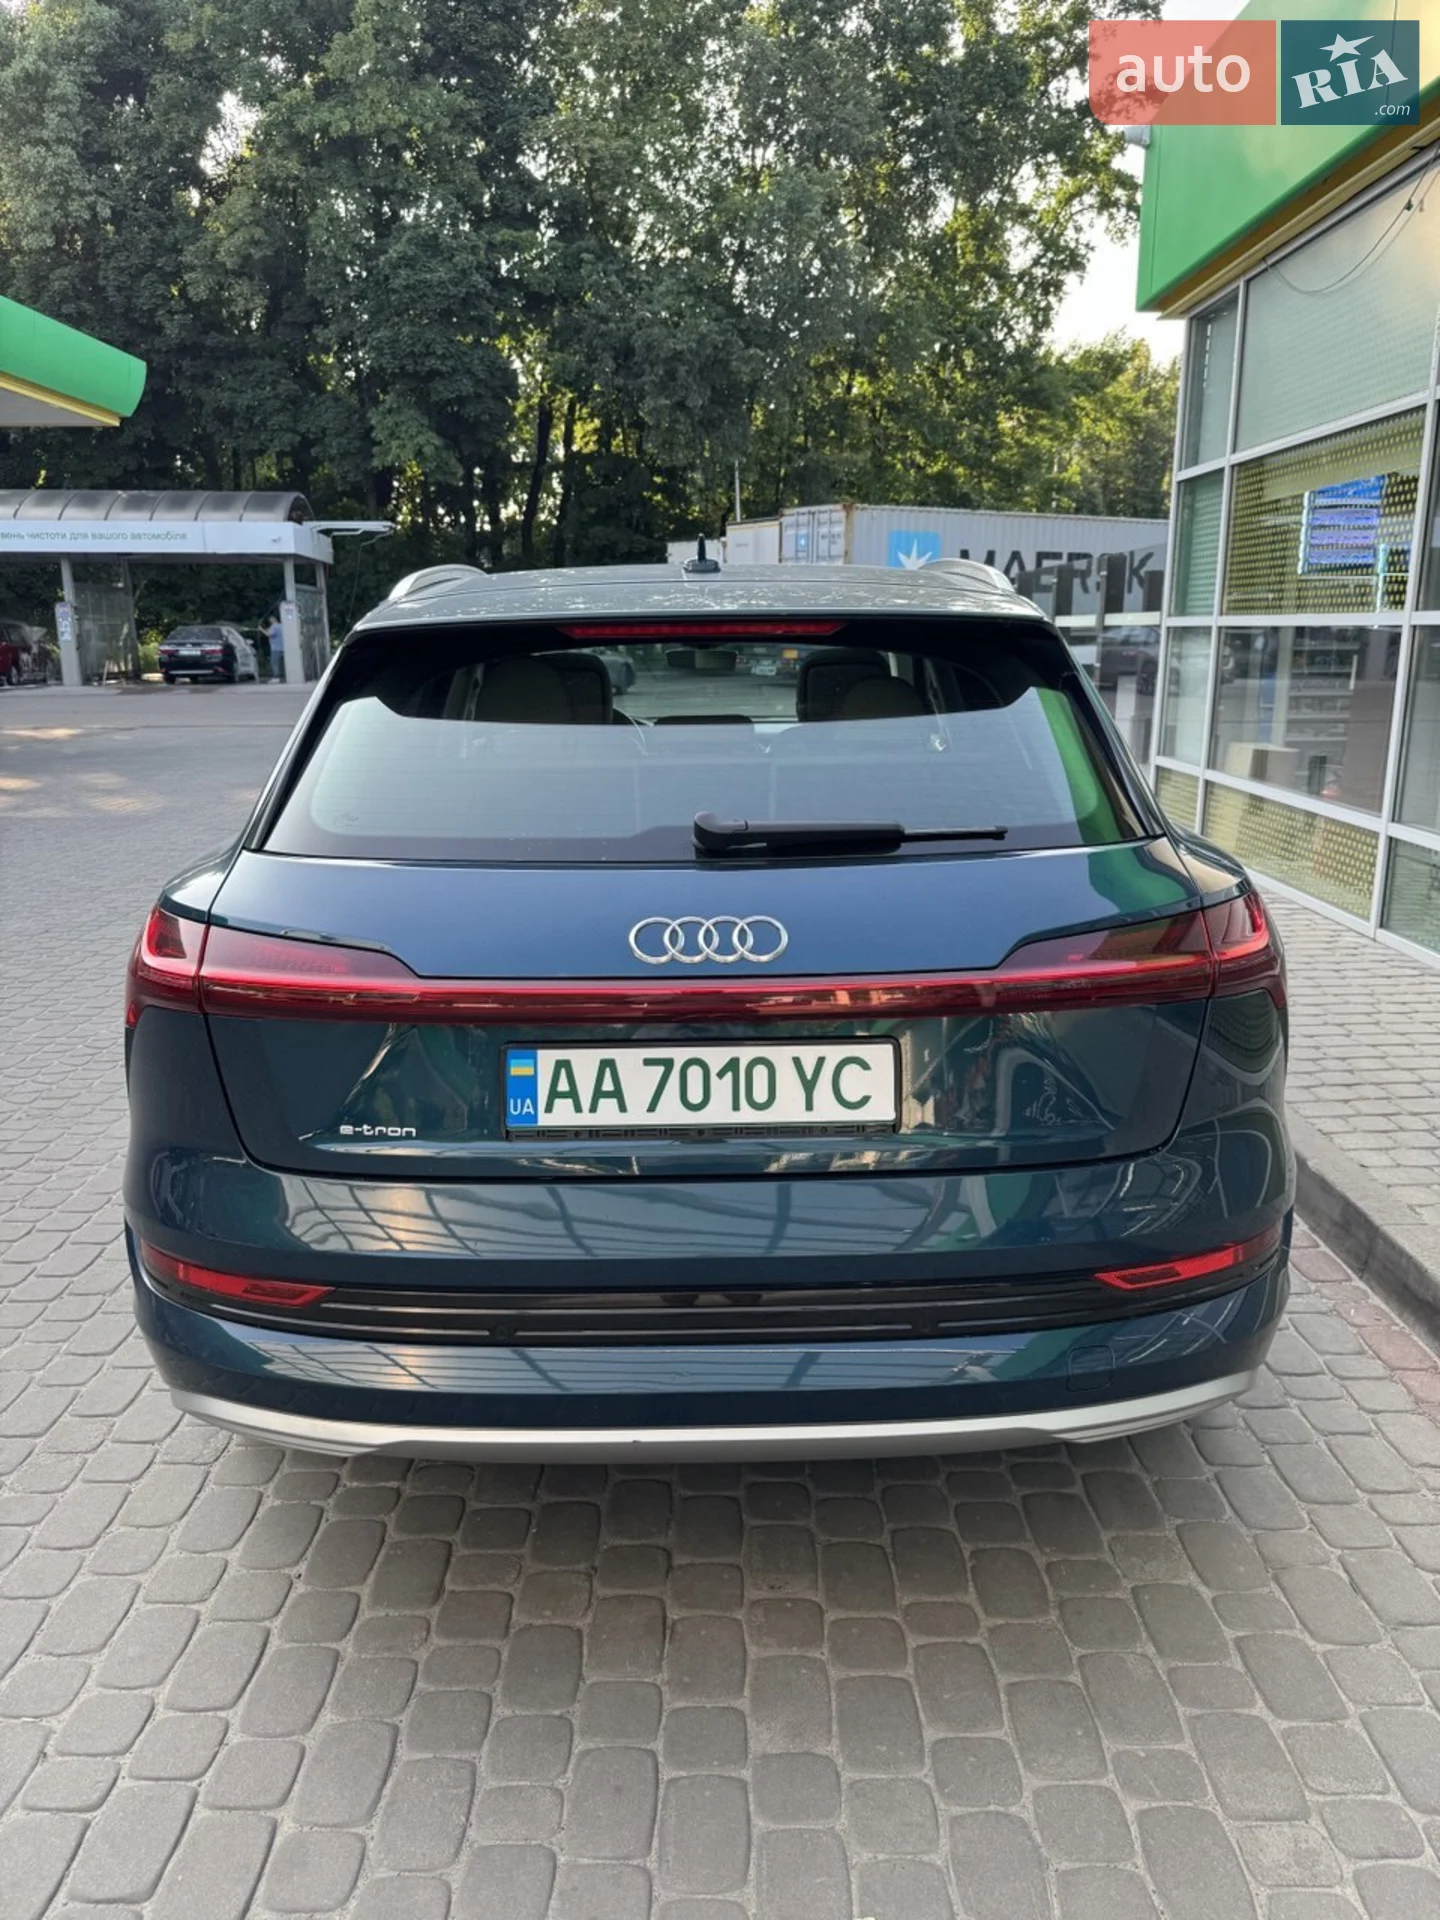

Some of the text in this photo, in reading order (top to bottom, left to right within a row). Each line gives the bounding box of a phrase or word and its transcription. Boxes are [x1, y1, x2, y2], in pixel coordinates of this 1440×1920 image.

[26, 531, 67, 540] чистоти
[69, 531, 89, 541] для
[91, 531, 129, 541] вашого
[130, 529, 188, 541] автомобіля
[544, 1056, 873, 1114] AA 7010 YC
[510, 1098, 535, 1116] UA
[340, 1124, 417, 1138] e-tron
